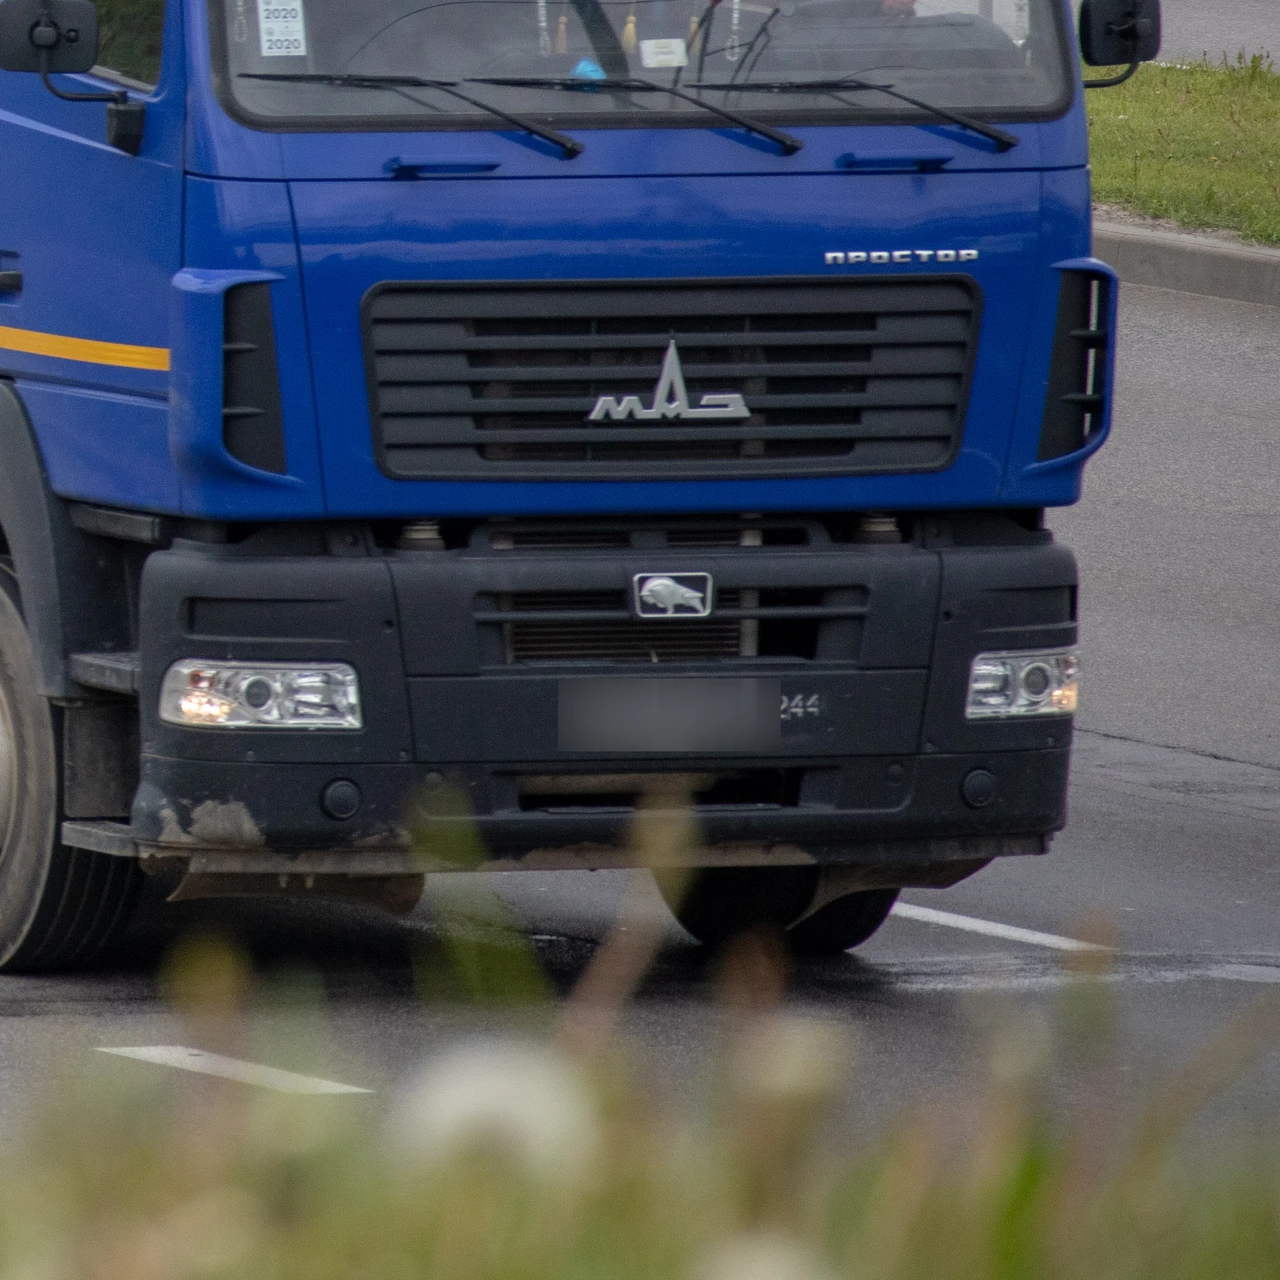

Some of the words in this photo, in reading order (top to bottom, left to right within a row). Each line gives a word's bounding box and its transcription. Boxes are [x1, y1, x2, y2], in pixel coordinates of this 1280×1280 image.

[263, 8, 298, 20] 2020
[265, 38, 301, 50] 2020
[825, 249, 980, 265] ПРОСТОР
